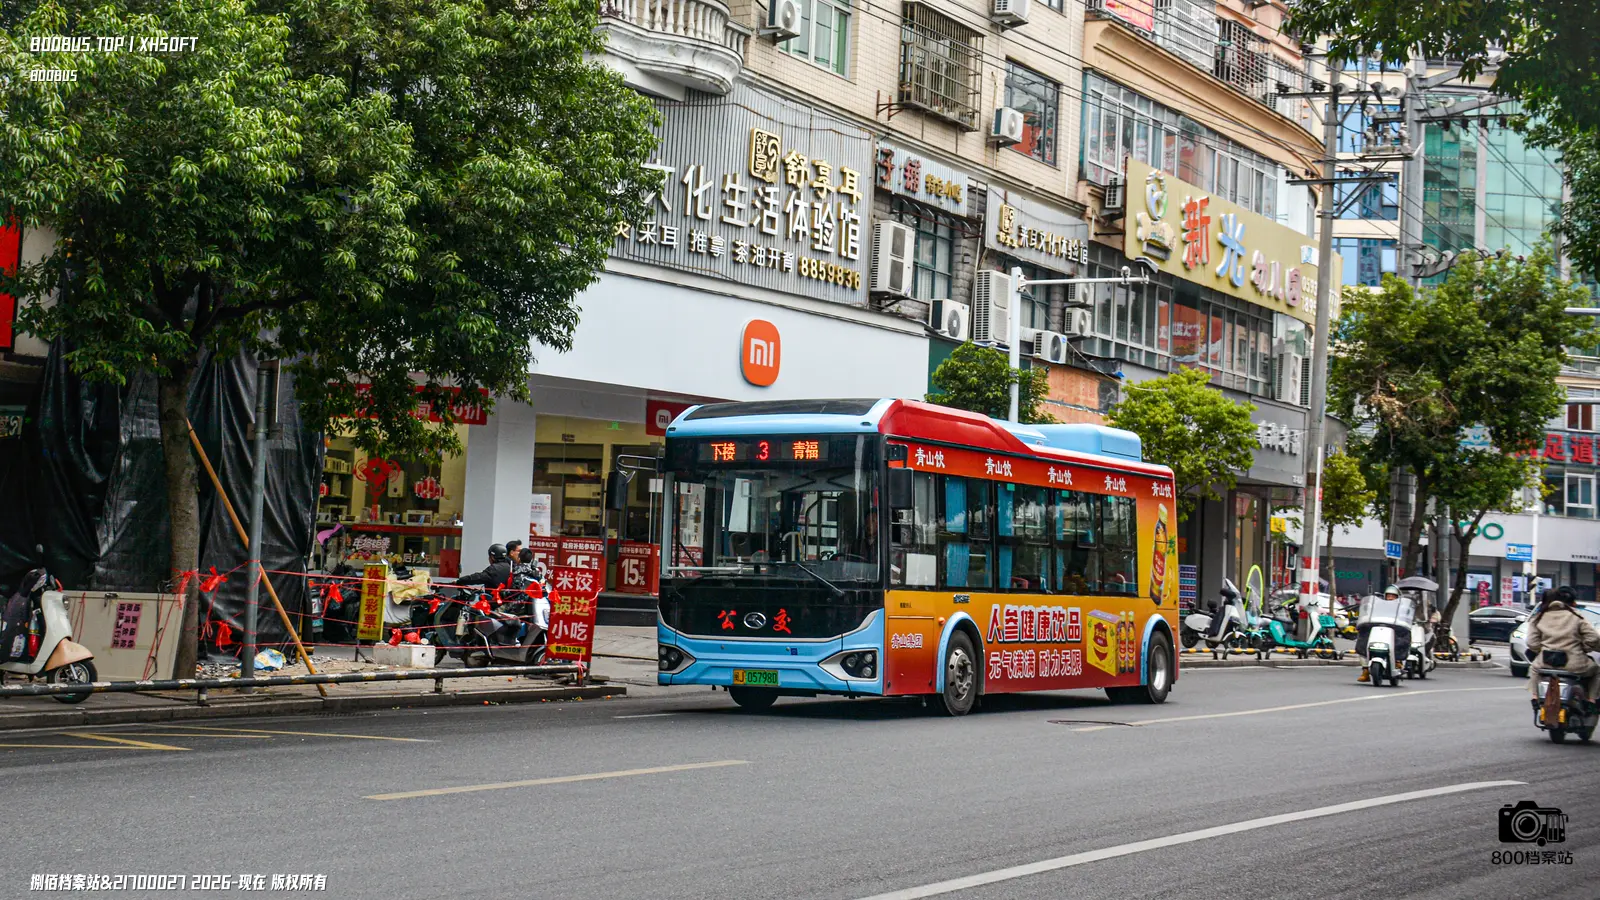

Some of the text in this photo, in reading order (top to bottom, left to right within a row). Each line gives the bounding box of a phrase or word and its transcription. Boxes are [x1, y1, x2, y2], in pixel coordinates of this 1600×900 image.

[783, 149, 863, 205] 舒享耳
[639, 157, 861, 261] 文化生活体验馆
[690, 228, 726, 258] 推拿
[734, 239, 794, 273] 茶油开背
[799, 255, 862, 291] 8859836
[711, 440, 819, 461] 下楼 3 青福
[915, 447, 946, 469] 青山饮
[984, 457, 1013, 477] 青山饮
[1047, 466, 1073, 486] 青山饮
[1104, 475, 1127, 493] 青山饮
[1151, 482, 1172, 498] 青山饮
[556, 570, 594, 593] 米饺
[363, 567, 382, 629] 体育彩票
[551, 619, 589, 643] 小吃
[717, 608, 792, 635] 公 交
[891, 633, 923, 649] 青山集团
[989, 648, 1082, 679] 元气满满 耐力无限
